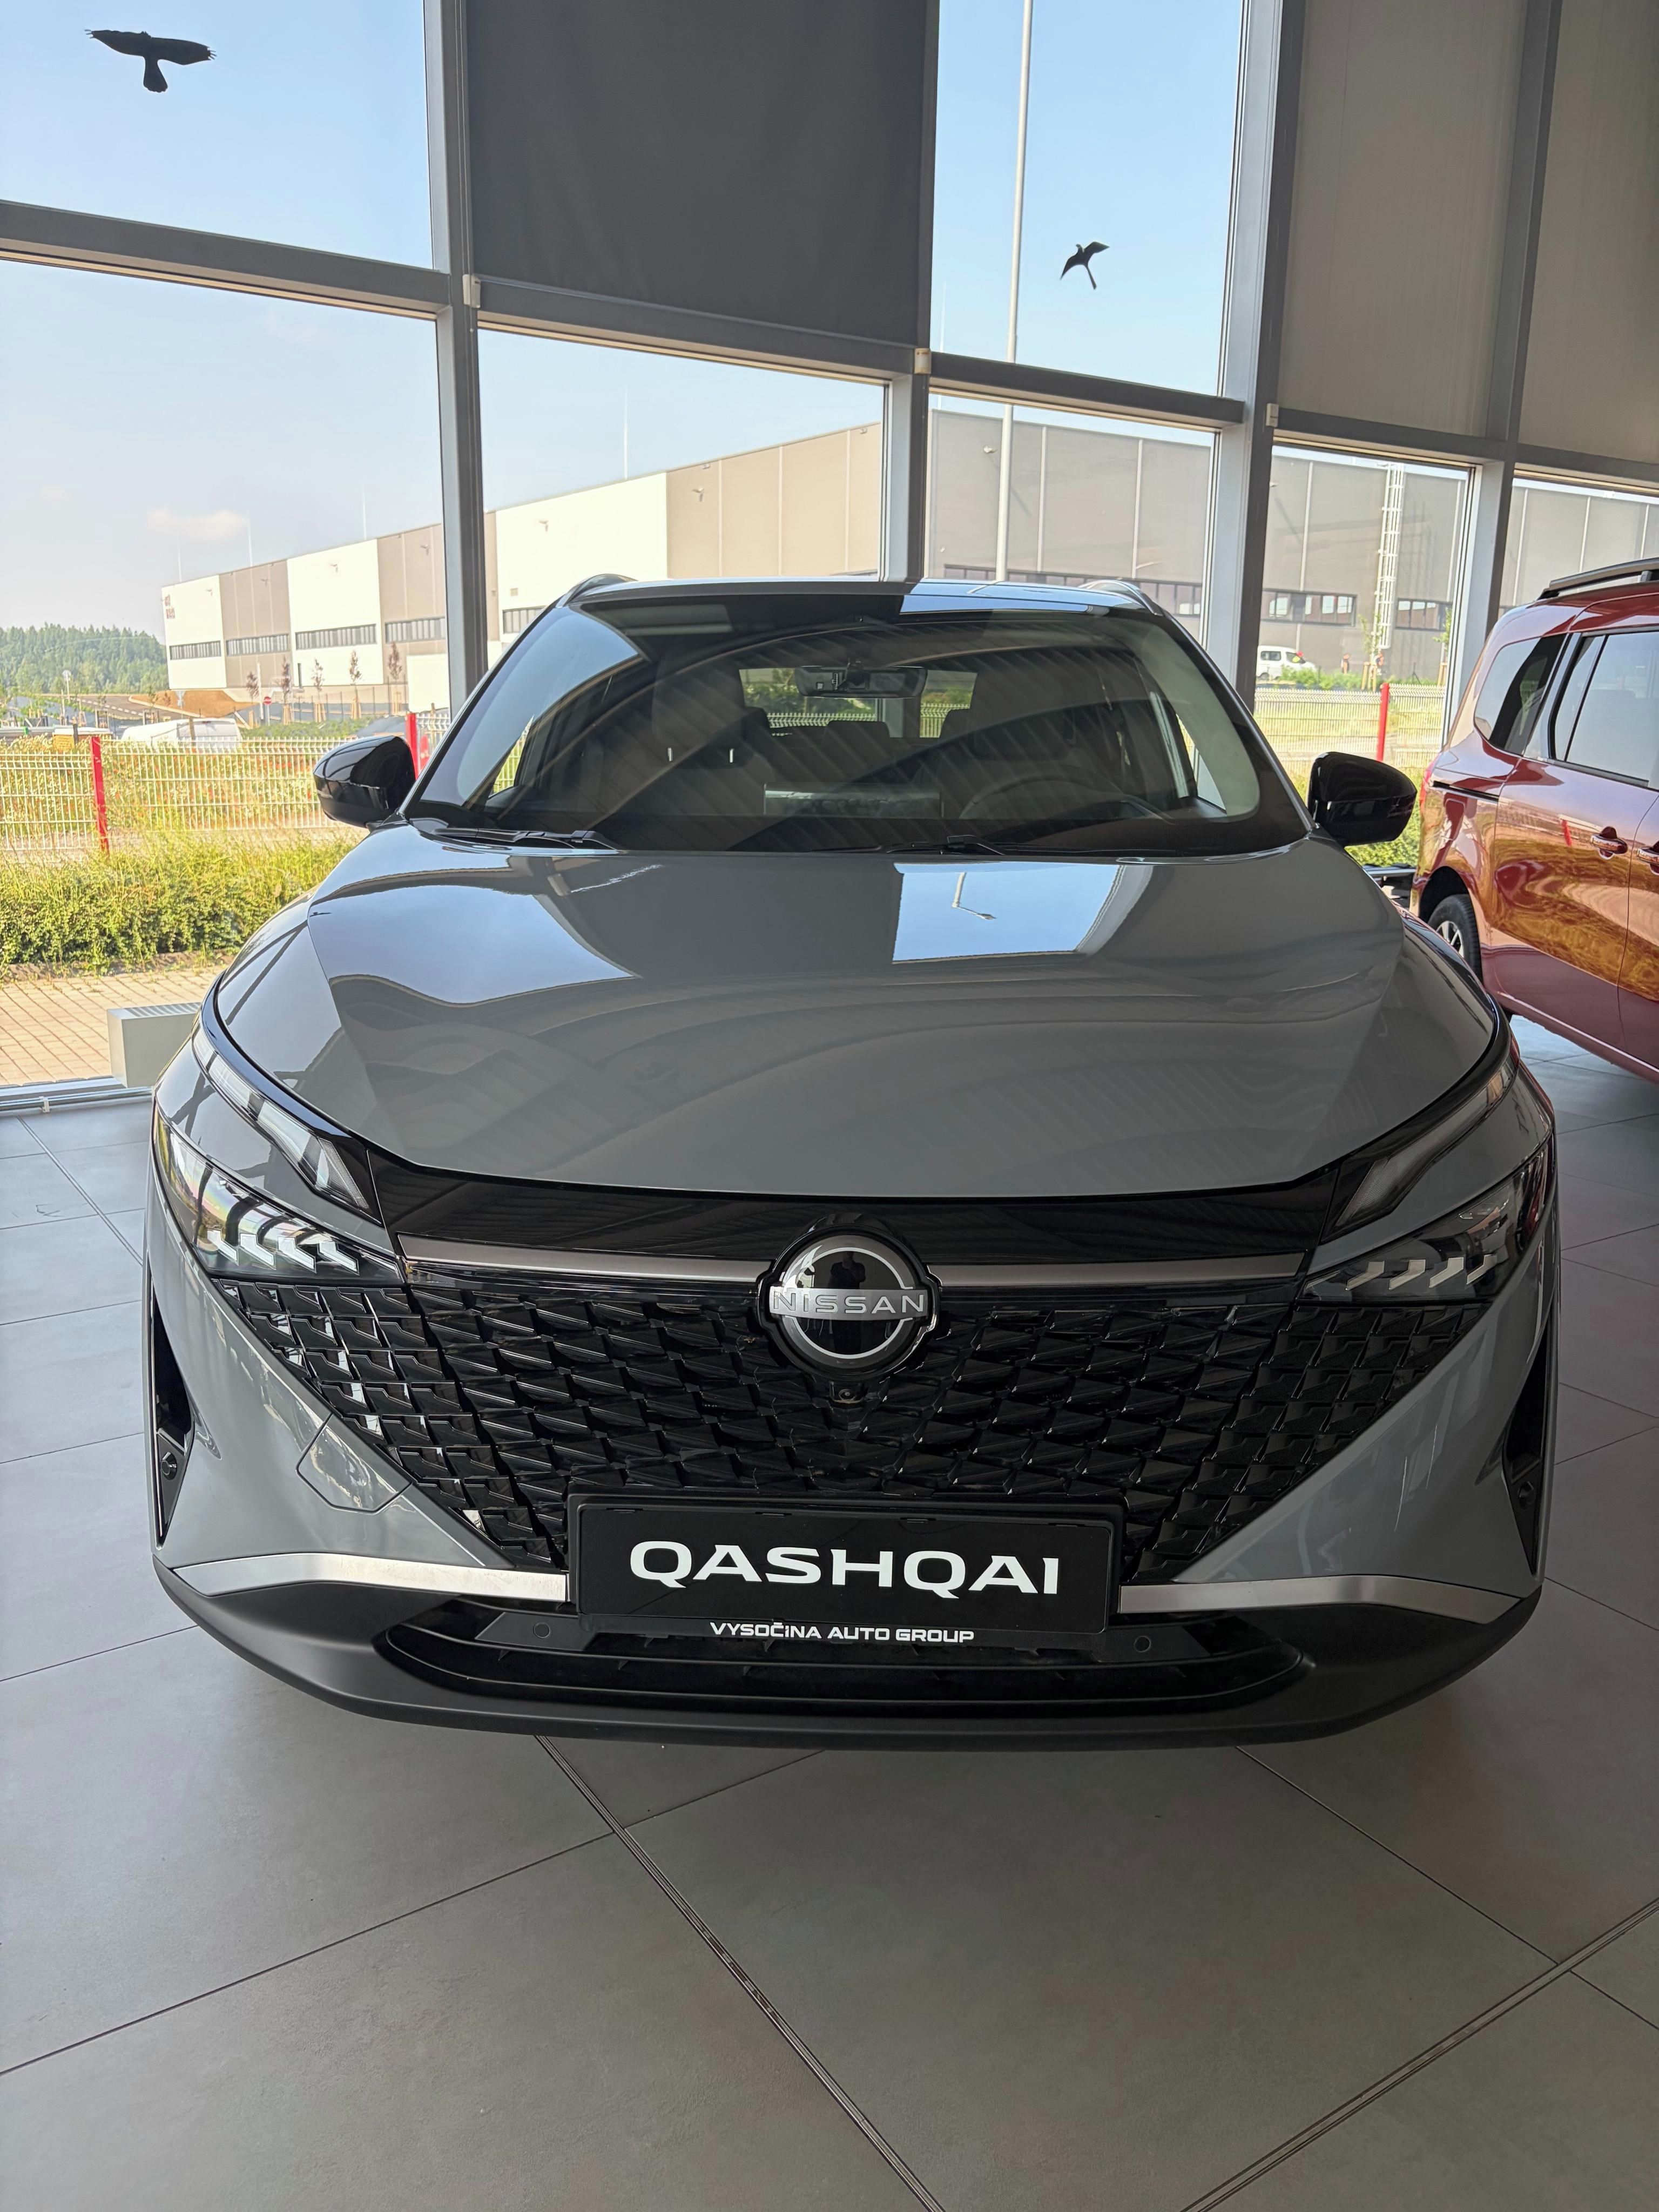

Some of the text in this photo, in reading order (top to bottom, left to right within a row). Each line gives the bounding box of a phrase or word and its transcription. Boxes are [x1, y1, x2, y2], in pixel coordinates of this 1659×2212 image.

[773, 1290, 925, 1314] NISSAN
[630, 1540, 1060, 1600] QASHQAI
[710, 1622, 974, 1643] VYSOČINA AUTO GROUP
